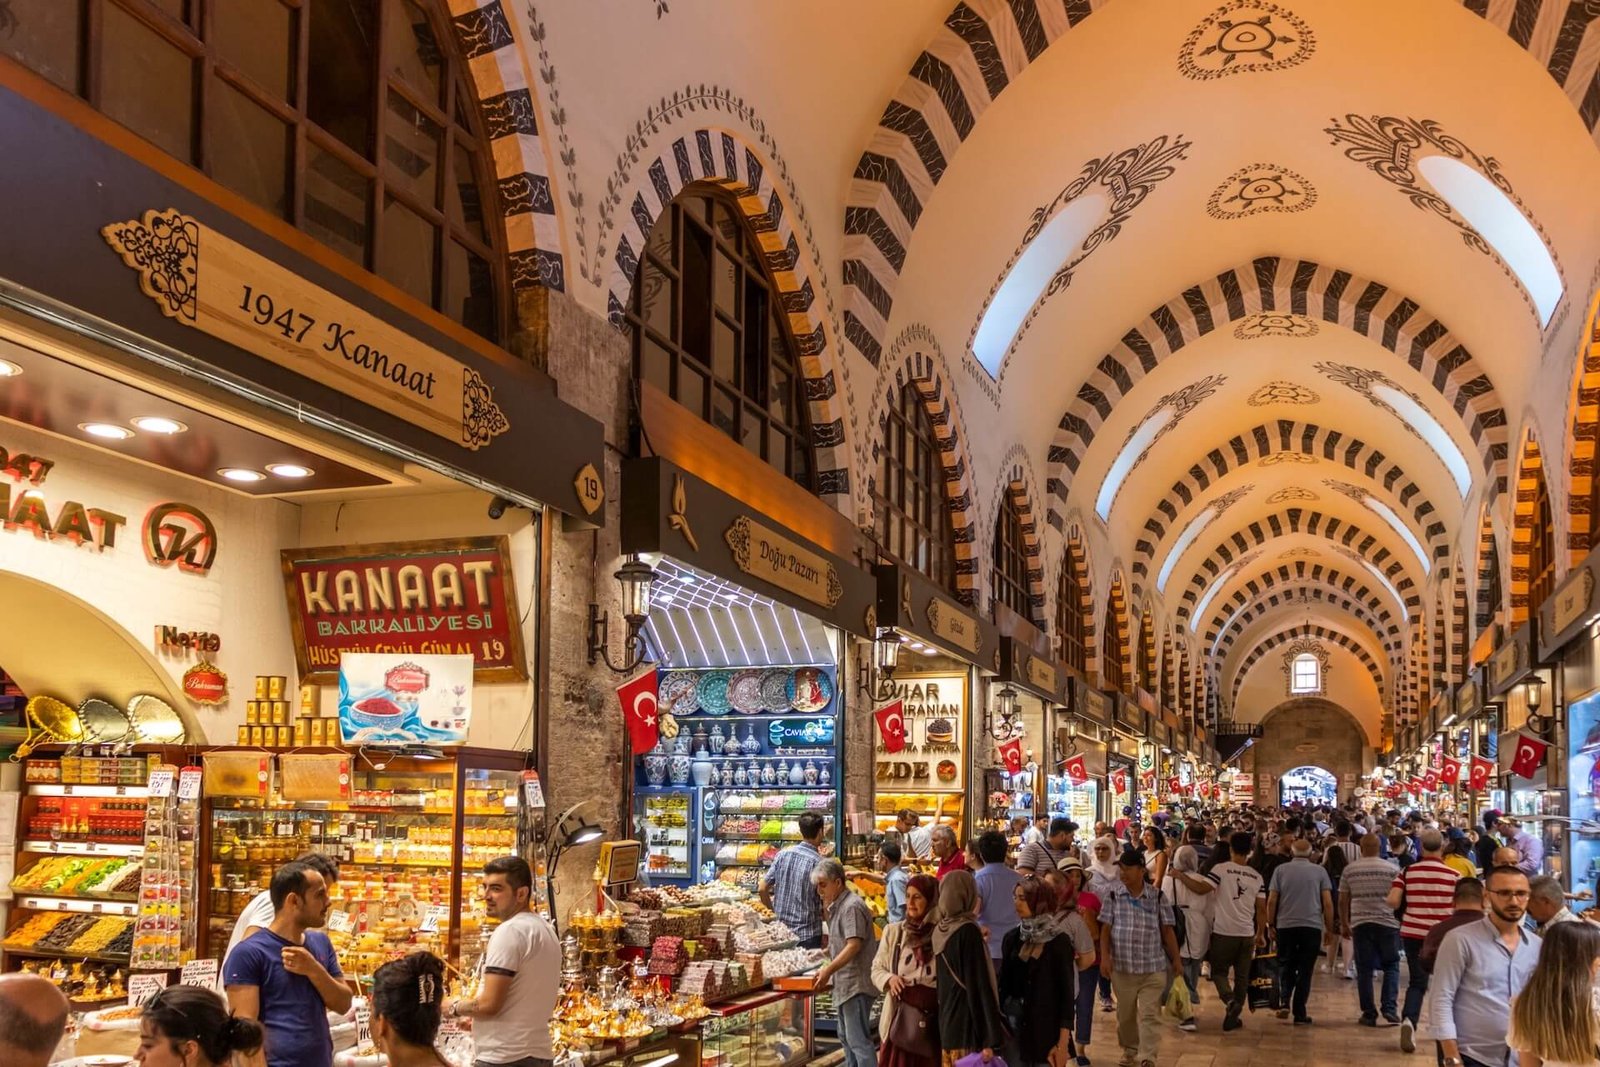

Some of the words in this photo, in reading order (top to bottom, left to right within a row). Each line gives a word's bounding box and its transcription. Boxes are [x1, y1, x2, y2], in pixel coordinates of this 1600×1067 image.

[239, 285, 315, 343] 1947
[322, 322, 436, 399] Kanaat
[584, 477, 598, 501] 19
[760, 540, 787, 572] Doğu
[788, 554, 819, 585] Pazarı
[301, 561, 494, 614] KANAAT
[317, 611, 493, 636] BAKKALİYESİ
[482, 640, 506, 661] 19
[904, 704, 959, 716] IRANIAN
